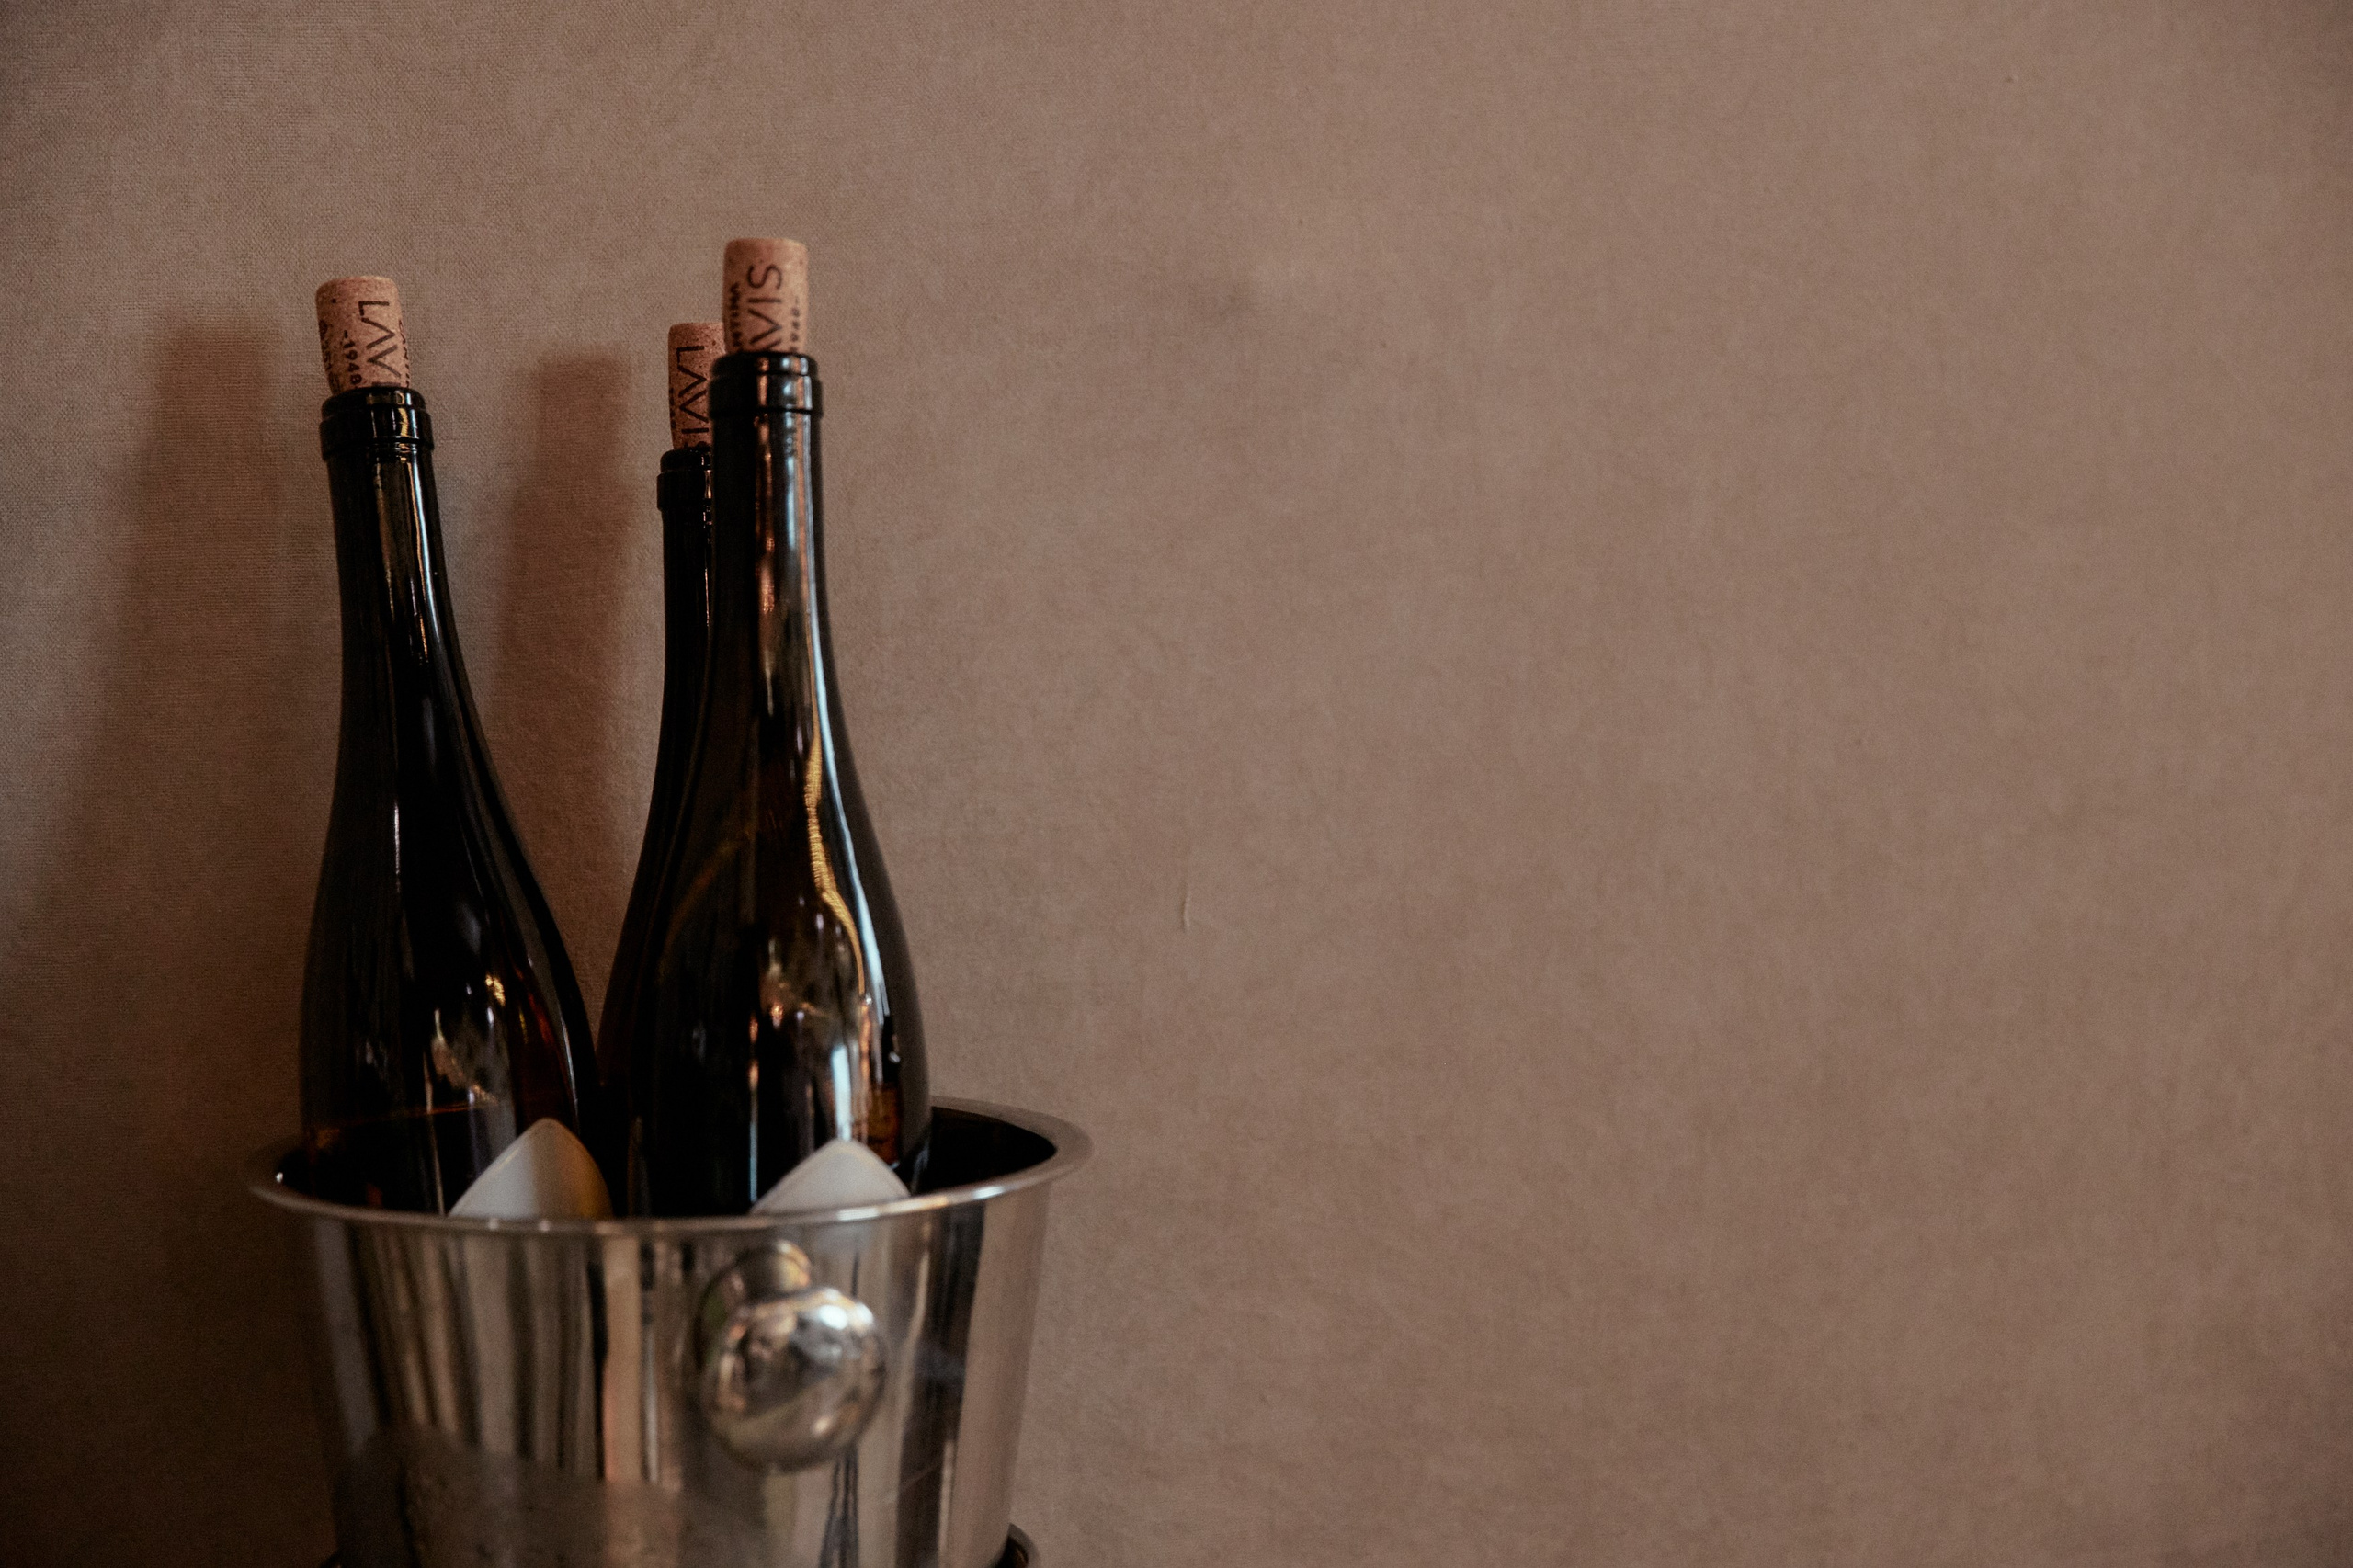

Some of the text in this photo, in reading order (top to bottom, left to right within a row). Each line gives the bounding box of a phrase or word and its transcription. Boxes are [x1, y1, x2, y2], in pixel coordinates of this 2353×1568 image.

[358, 301, 402, 387] LAVI
[747, 264, 782, 349] VIS
[676, 346, 710, 447] LAVI
